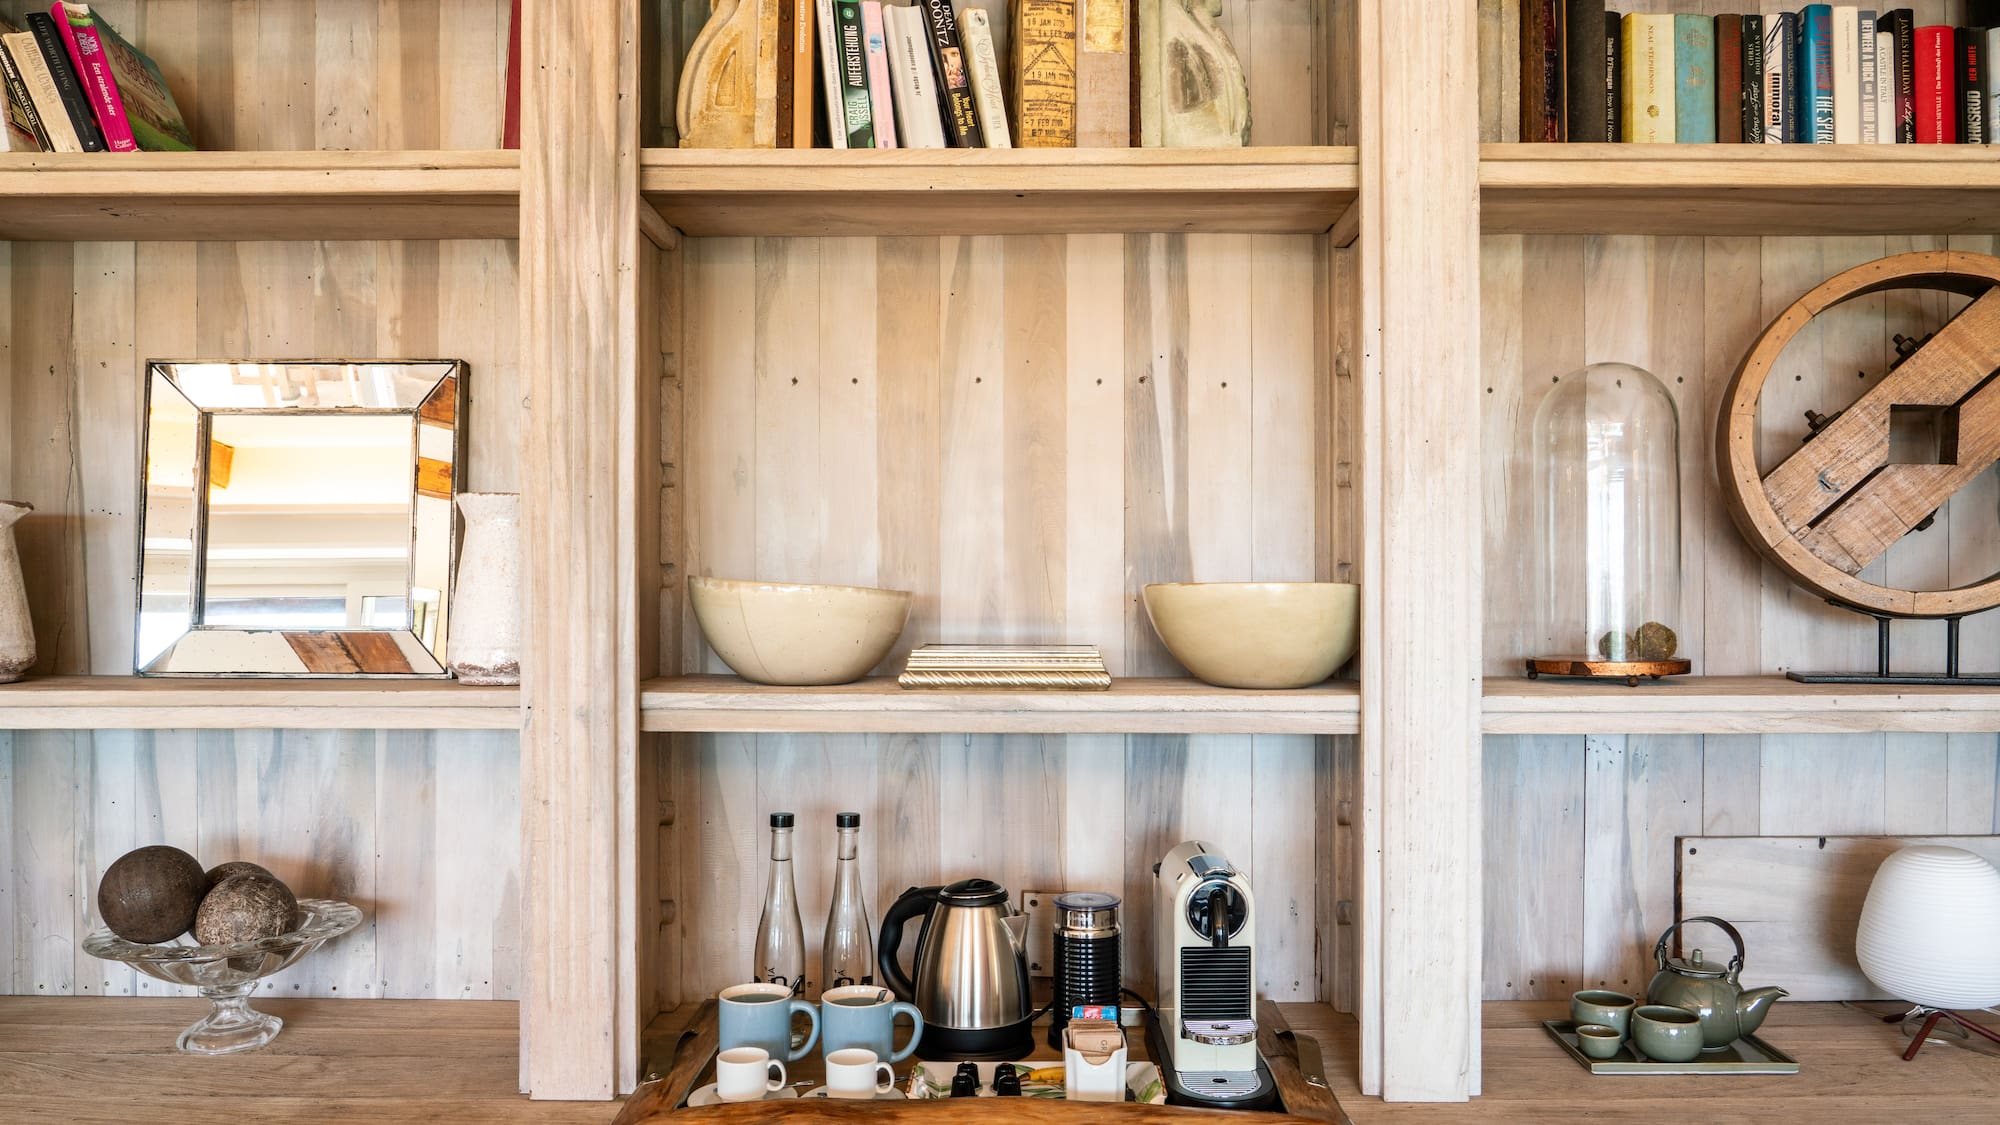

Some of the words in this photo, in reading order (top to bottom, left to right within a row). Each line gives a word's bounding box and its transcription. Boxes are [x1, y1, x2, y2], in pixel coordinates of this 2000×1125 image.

[930, 0, 949, 47] OONTZ
[942, 5, 954, 31] DEAN
[77, 32, 92, 55] ROBERTS
[88, 36, 99, 53] NORA
[1862, 20, 1874, 52] BETWEEN
[1899, 18, 1910, 49] JAMES
[45, 39, 60, 66] WORTH
[55, 64, 71, 91] LIVING
[844, 25, 863, 86] AUFERSTEHUNG
[1968, 45, 1977, 65] HIRTE
[92, 63, 101, 74] Een
[97, 75, 112, 103] stralende
[1606, 57, 1614, 89] O'Flanagan
[1862, 63, 1874, 81] ROCK
[1902, 50, 1911, 95] HALLIDAY
[1968, 68, 1977, 81] DER
[14, 80, 28, 106] EXPRESS
[1772, 73, 1781, 126] immoral
[1816, 96, 1833, 113] THE
[24, 104, 36, 126] TOKYO
[848, 101, 858, 126] CRAIG
[857, 96, 870, 128] RUSSELL
[952, 93, 962, 116] Belongs
[960, 125, 969, 136] Me
[965, 110, 975, 127] Heart
[1862, 102, 1875, 122] HARD
[1902, 108, 1912, 122] Life
